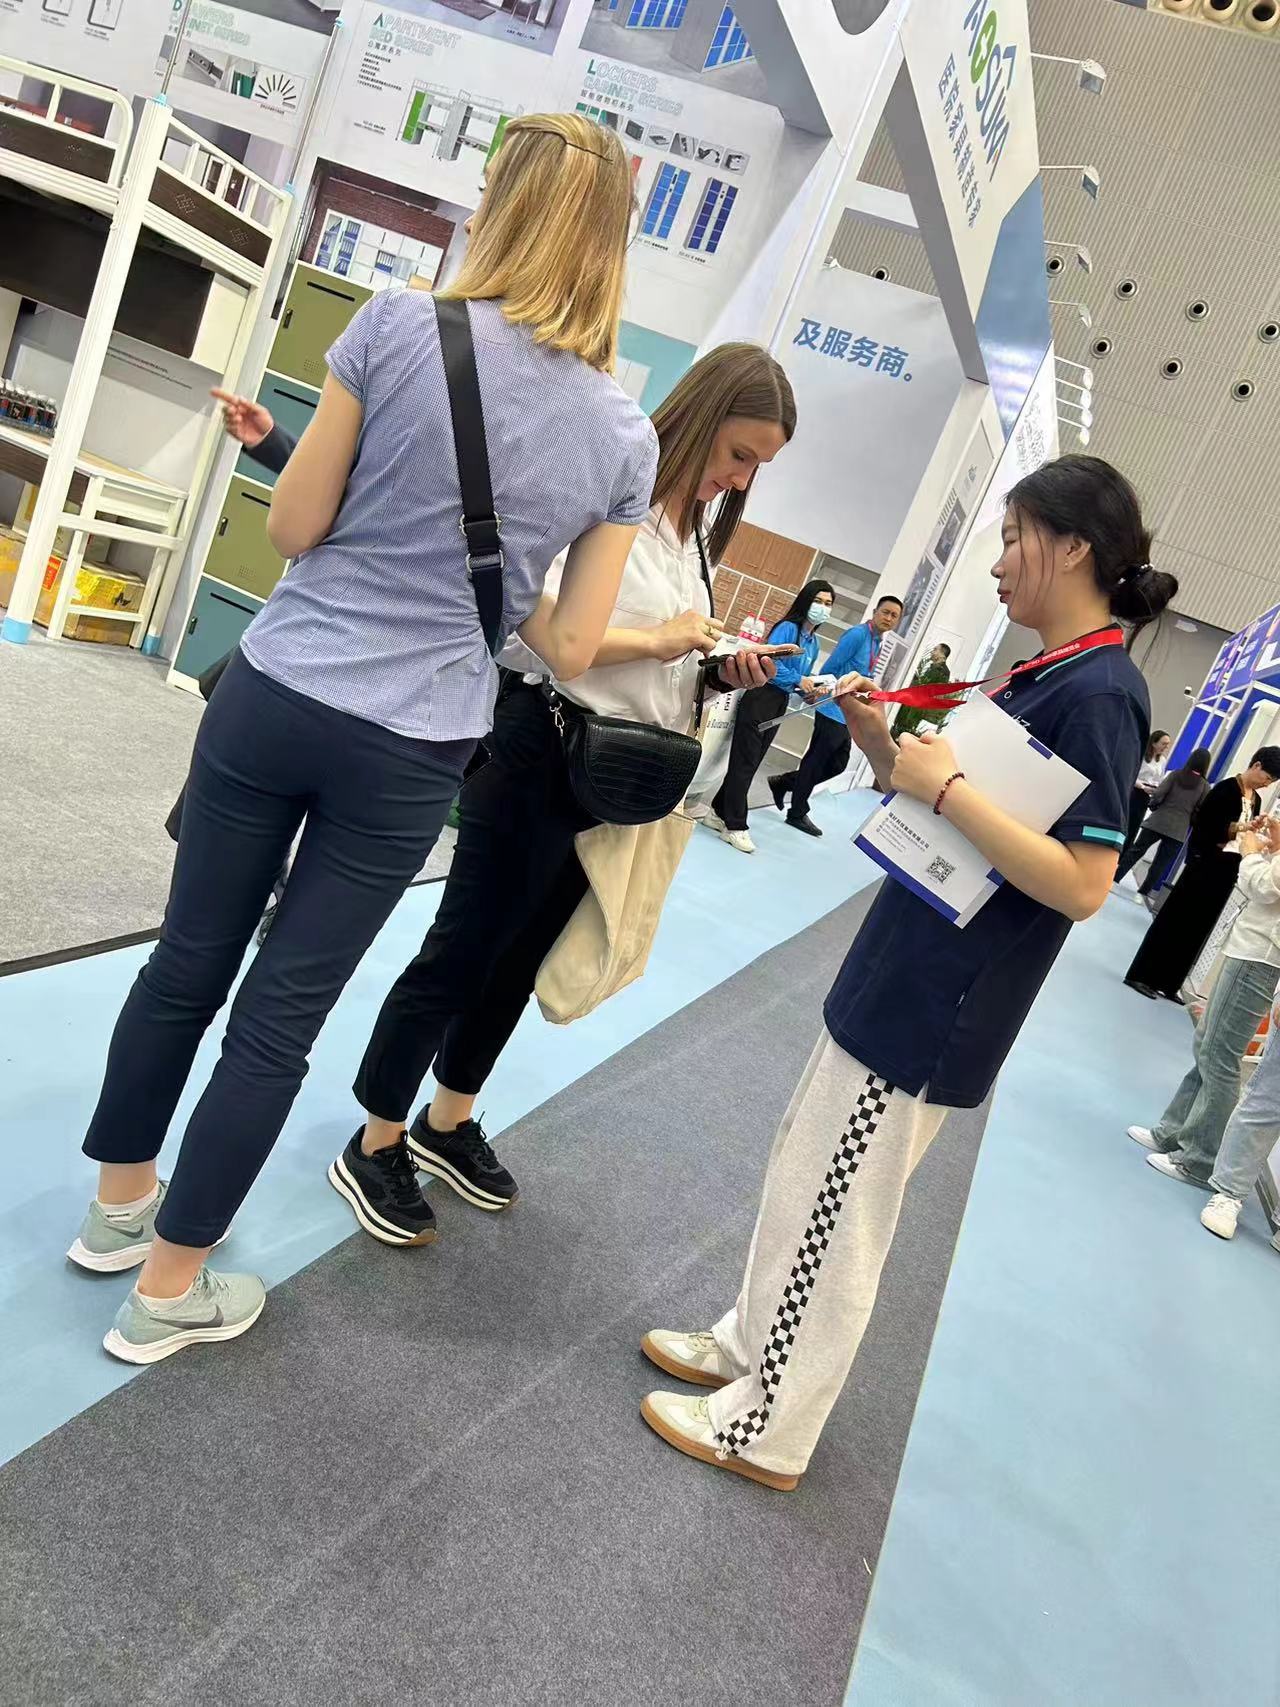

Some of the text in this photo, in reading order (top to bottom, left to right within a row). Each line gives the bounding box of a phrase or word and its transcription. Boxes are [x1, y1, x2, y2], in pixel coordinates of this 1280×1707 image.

[369, 26, 435, 56] BED SERIES
[373, 12, 462, 49] APARTMENT
[583, 74, 684, 116] CABINET SERIES
[587, 59, 658, 93] LOCKERS
[938, 52, 981, 229] 医院家具制造专家
[793, 317, 912, 382] 及服务商。
